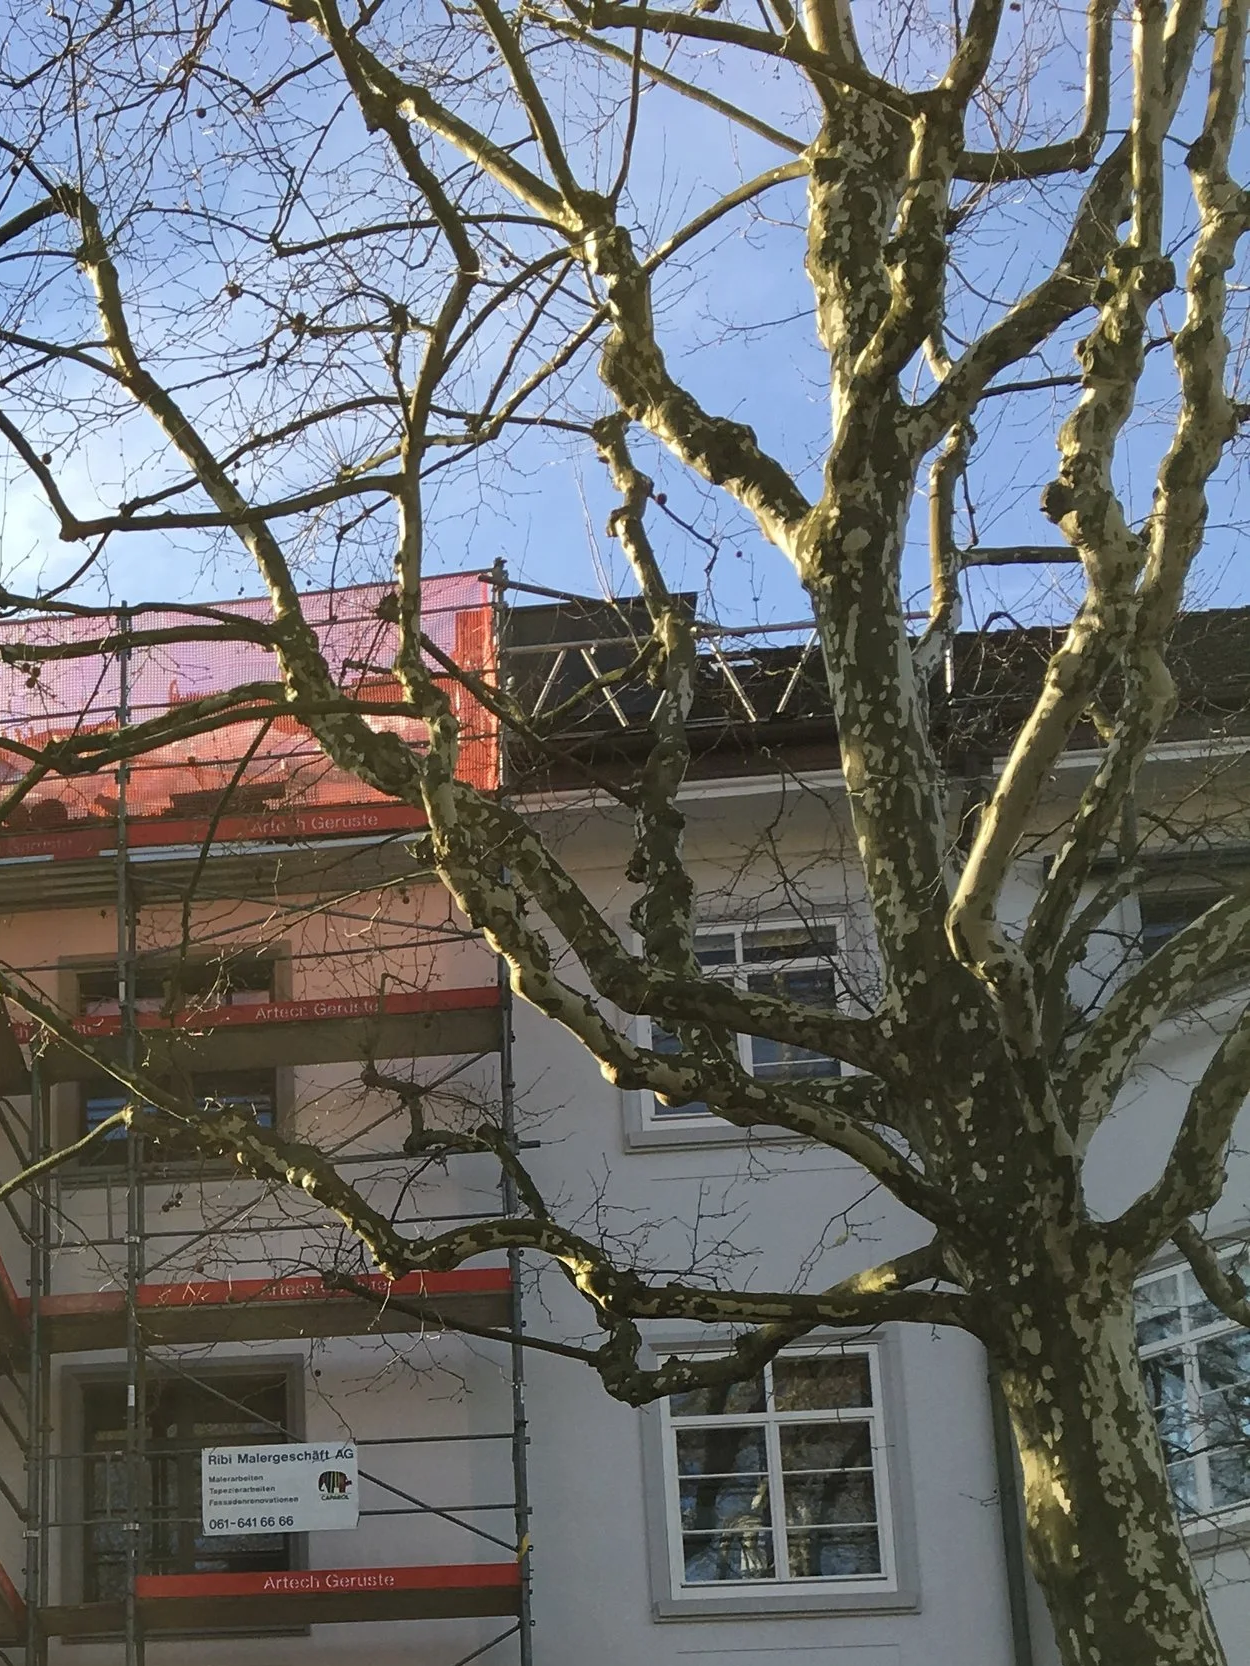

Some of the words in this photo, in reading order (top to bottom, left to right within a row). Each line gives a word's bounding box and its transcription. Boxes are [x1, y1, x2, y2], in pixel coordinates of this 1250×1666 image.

[208, 1453, 232, 1465] Ribi
[237, 1449, 330, 1465] Malergeschäft
[335, 1449, 354, 1459] AG
[208, 1474, 264, 1484] Malerarbeiten
[260, 1516, 275, 1527] 66
[278, 1515, 294, 1526] 66
[263, 1576, 320, 1589] Artech
